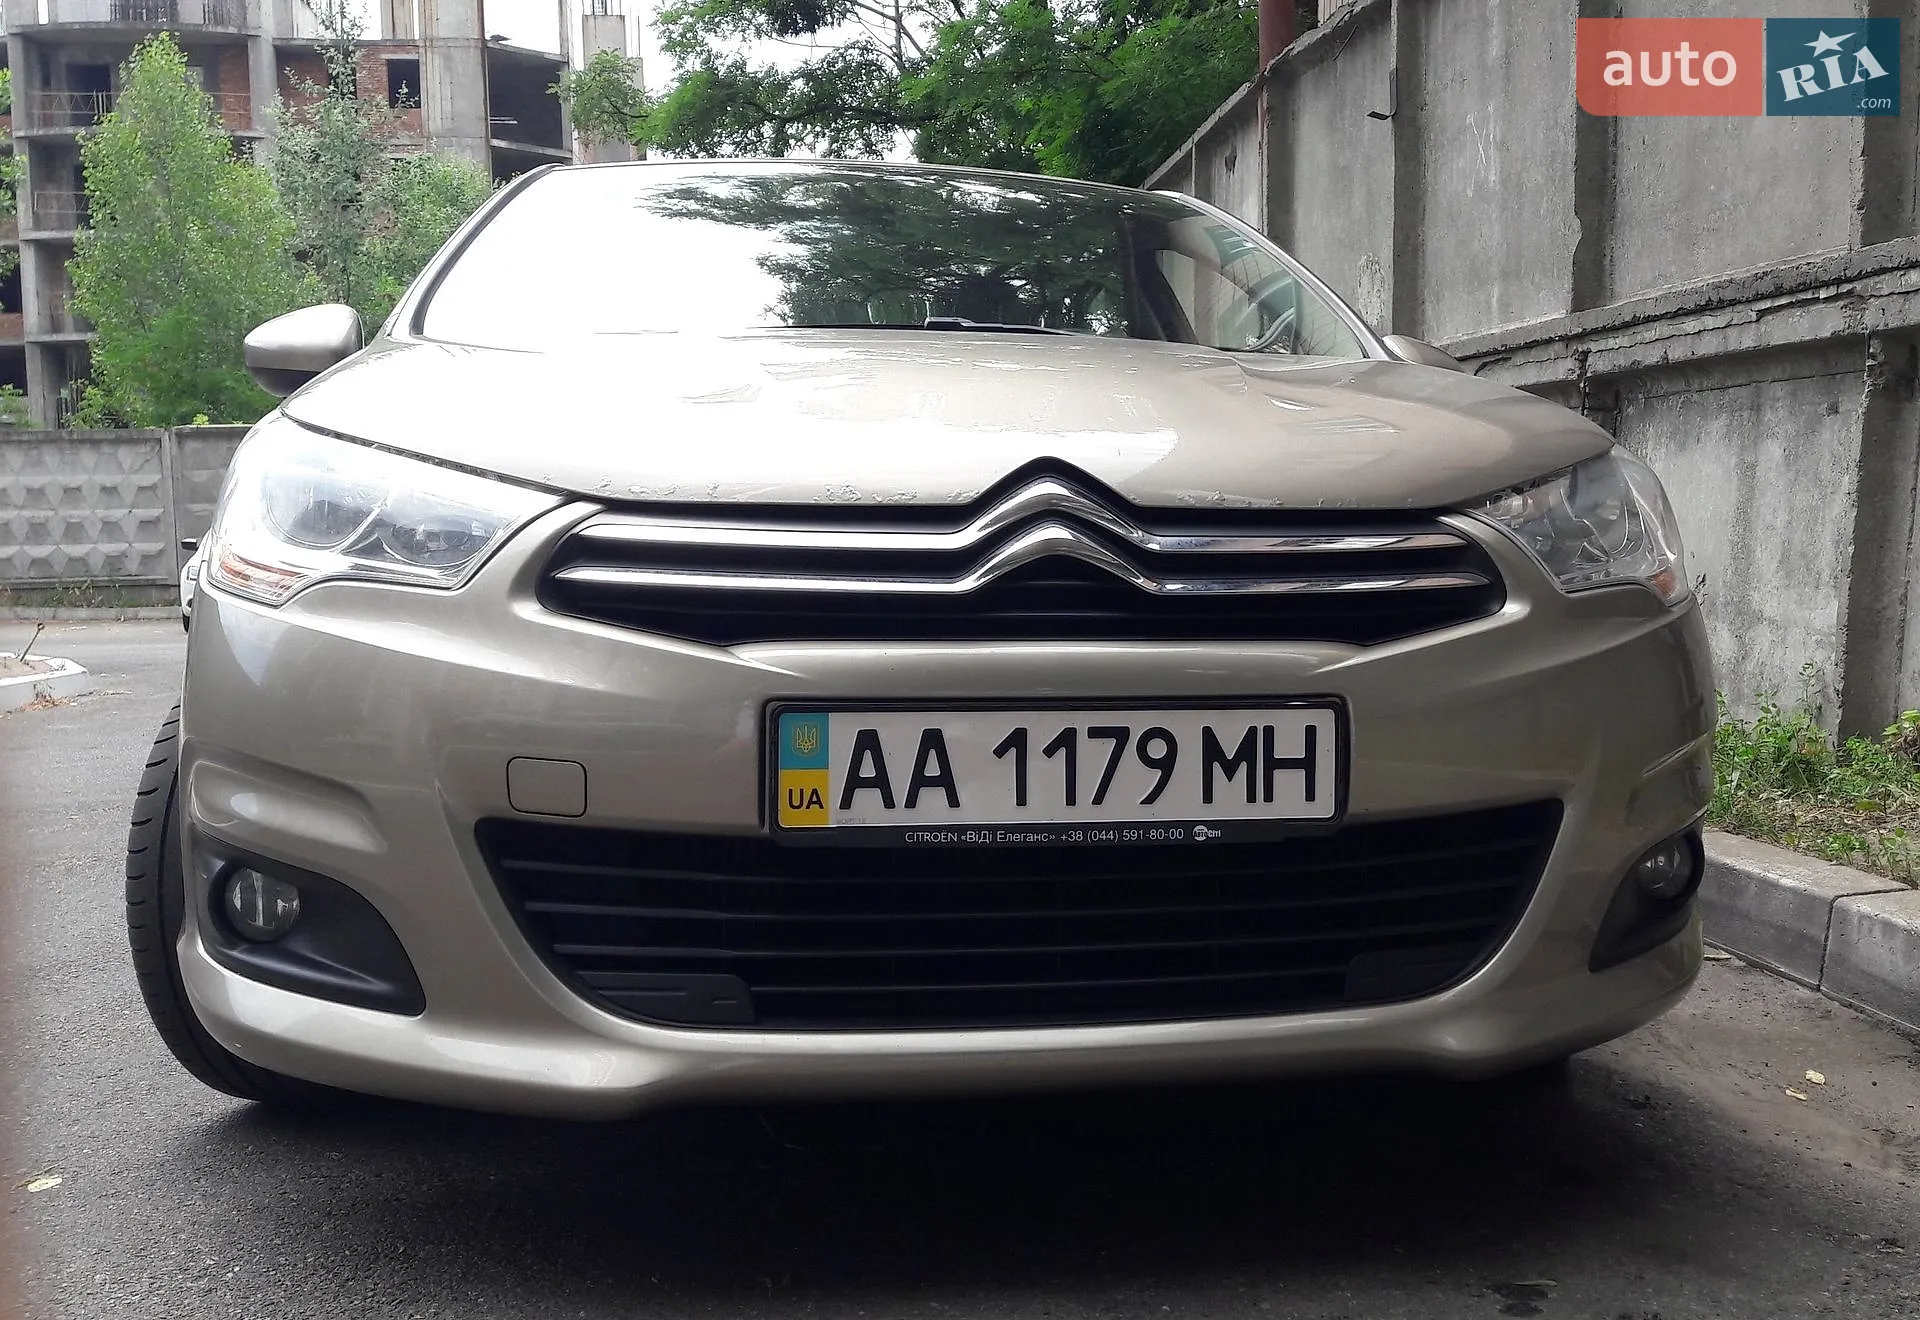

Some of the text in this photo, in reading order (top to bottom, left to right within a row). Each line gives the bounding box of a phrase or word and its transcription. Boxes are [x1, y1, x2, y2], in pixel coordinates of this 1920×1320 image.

[839, 724, 1318, 810] AA 1179 MH
[788, 787, 824, 810] UA
[905, 829, 957, 843] CITROËN
[1060, 830, 1084, 842] +38
[1087, 829, 1119, 844] (044)
[1122, 828, 1184, 841] 591-80-00
